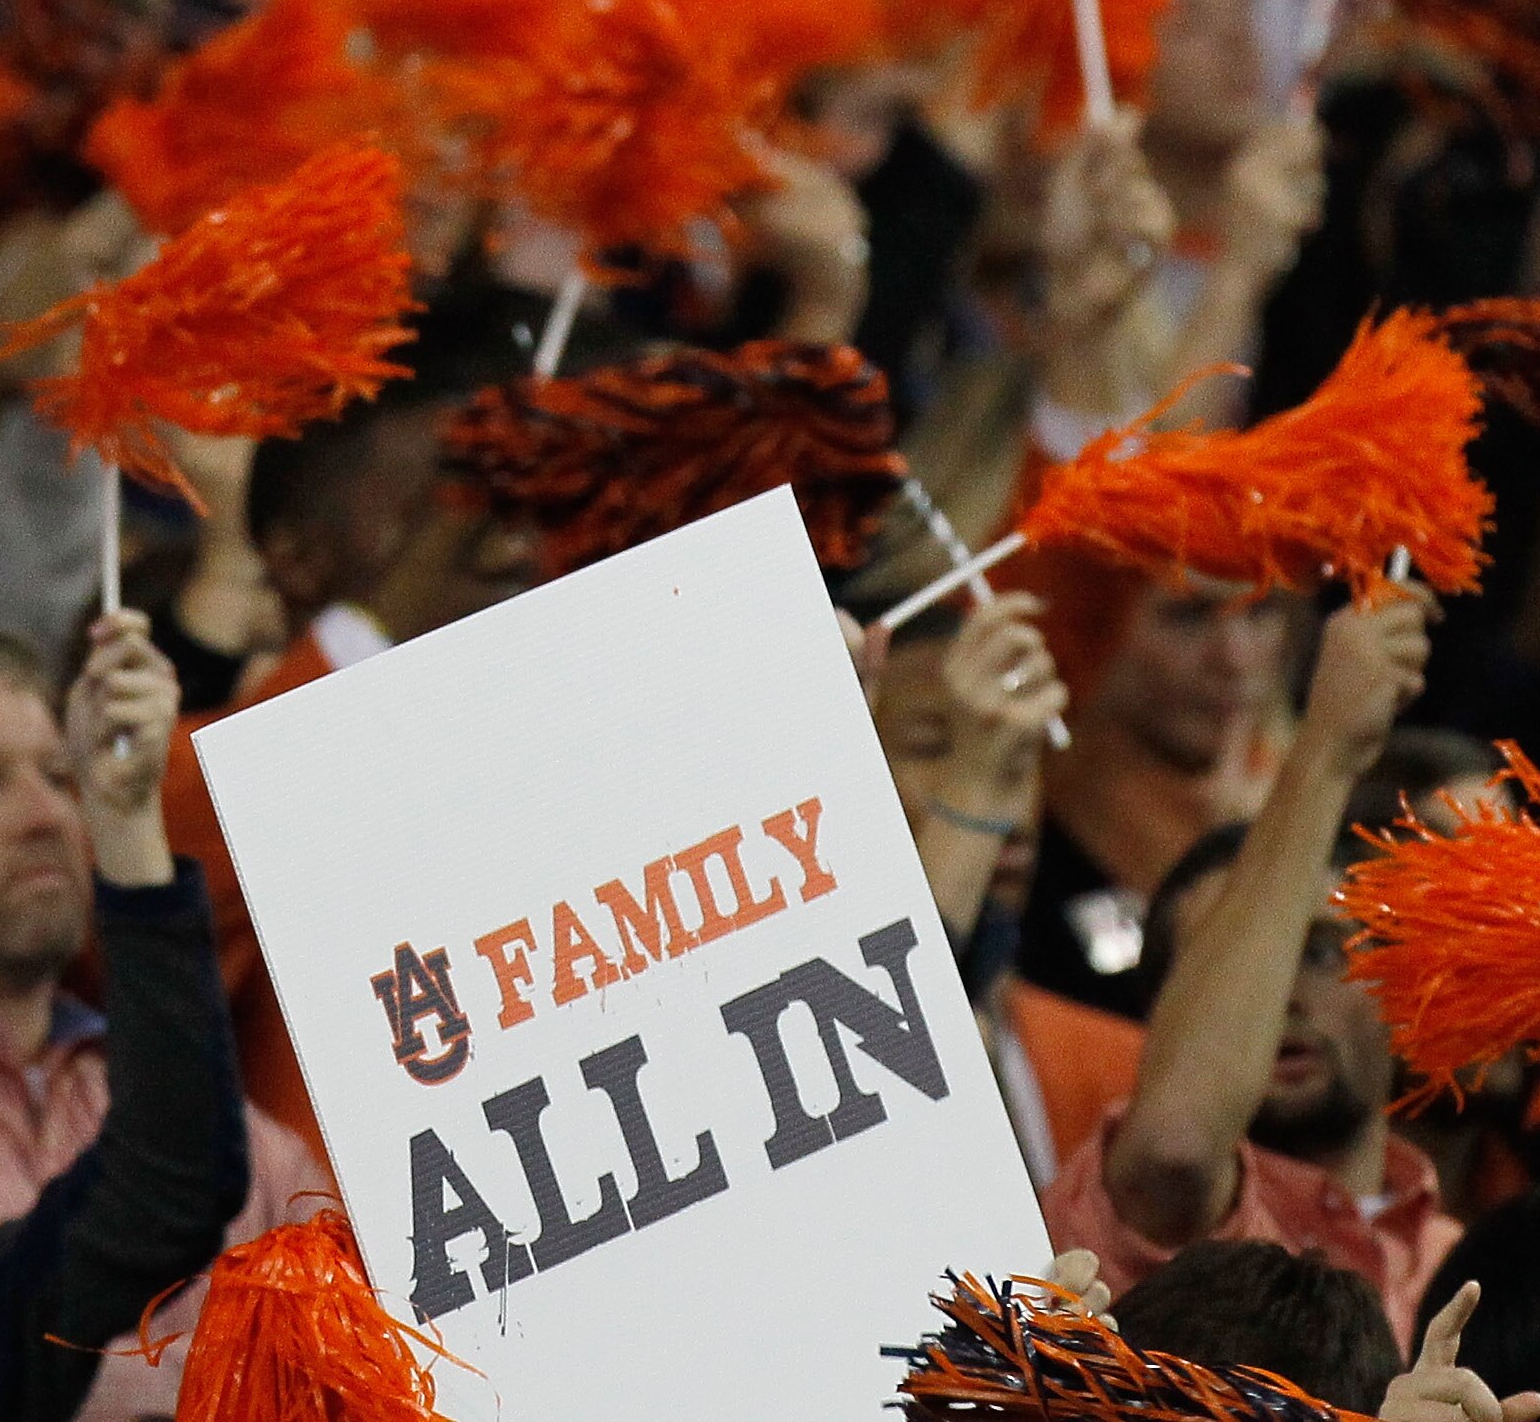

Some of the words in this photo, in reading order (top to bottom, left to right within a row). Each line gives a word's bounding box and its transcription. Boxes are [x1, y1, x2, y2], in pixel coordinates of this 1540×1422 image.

[474, 797, 837, 1030] FAMILY
[408, 1034, 729, 1325] ALL
[719, 916, 950, 1171] IN
